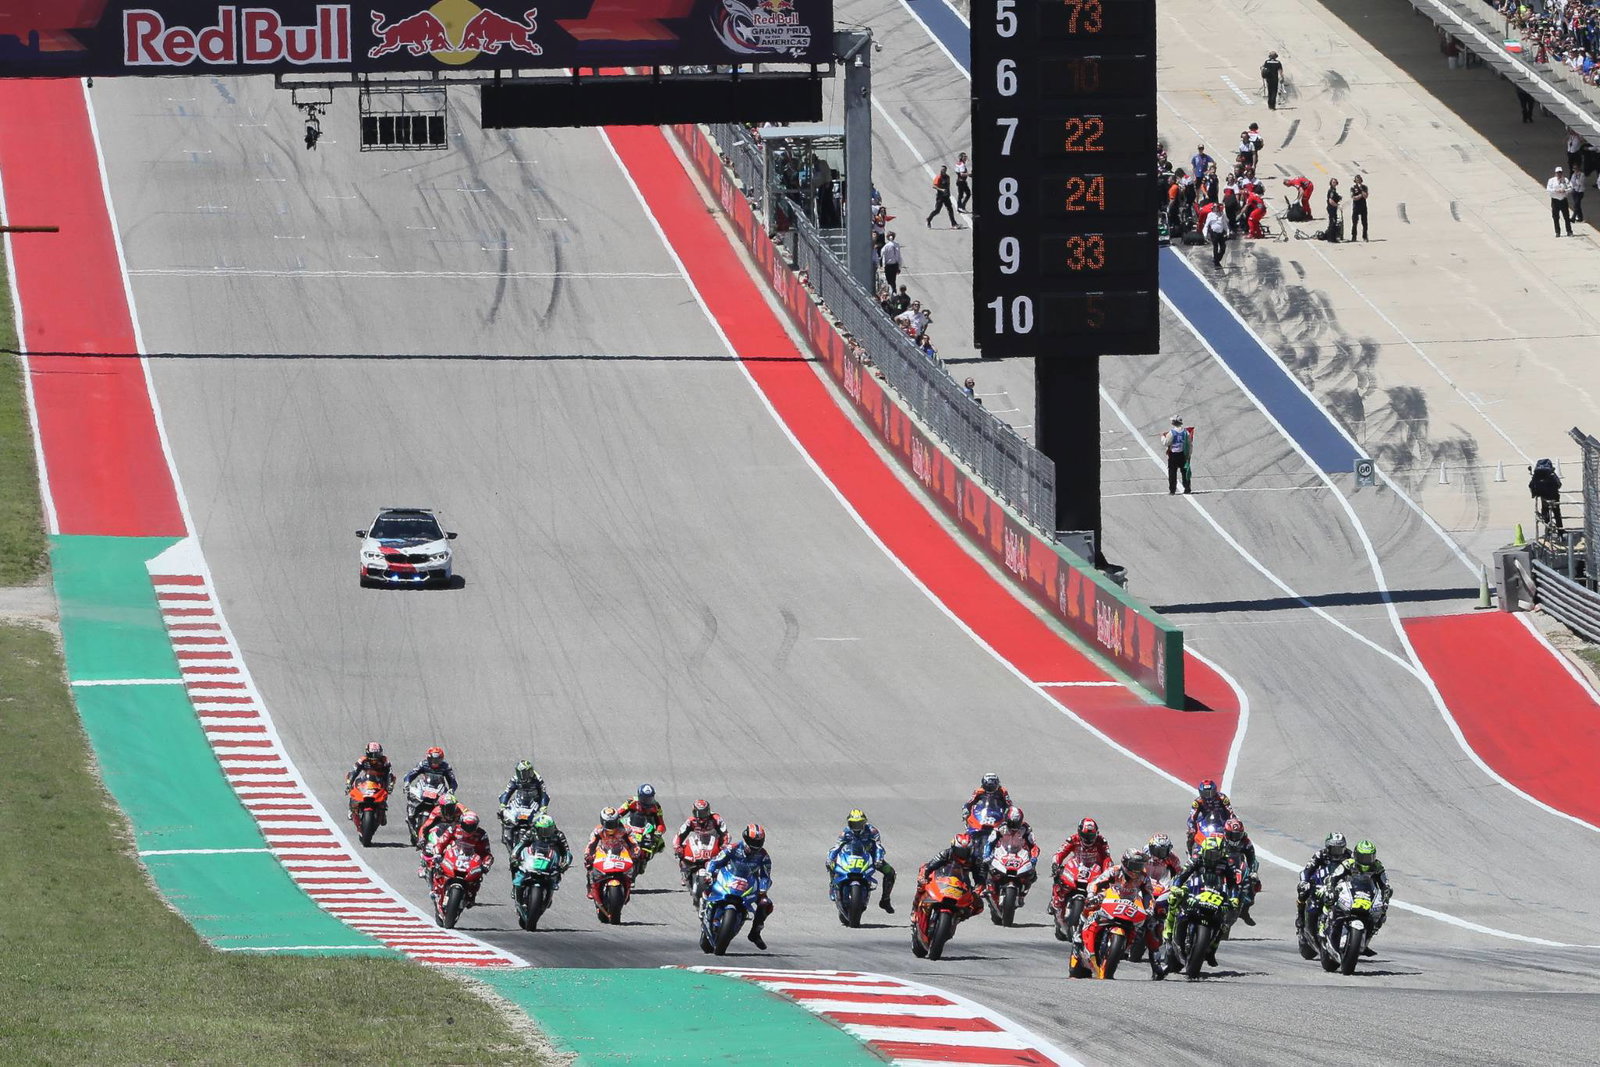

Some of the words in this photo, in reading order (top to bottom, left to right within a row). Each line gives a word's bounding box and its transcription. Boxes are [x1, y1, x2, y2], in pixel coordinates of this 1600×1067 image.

[751, 27, 783, 35] GRAND
[786, 27, 808, 35] PRIX
[996, 0, 1018, 38] 5
[1064, 0, 1103, 34] 73
[996, 58, 1018, 97] 6
[1067, 59, 1101, 93] 10
[996, 117, 1019, 156] 7
[1065, 117, 1105, 152] 22
[998, 177, 1020, 216] 8
[1065, 176, 1105, 212] 24
[998, 236, 1021, 275] 9
[1066, 235, 1105, 271] 33
[987, 295, 1034, 335] 10
[1087, 295, 1105, 328] 5
[1112, 903, 1138, 918] 93
[1196, 890, 1224, 907] 46
